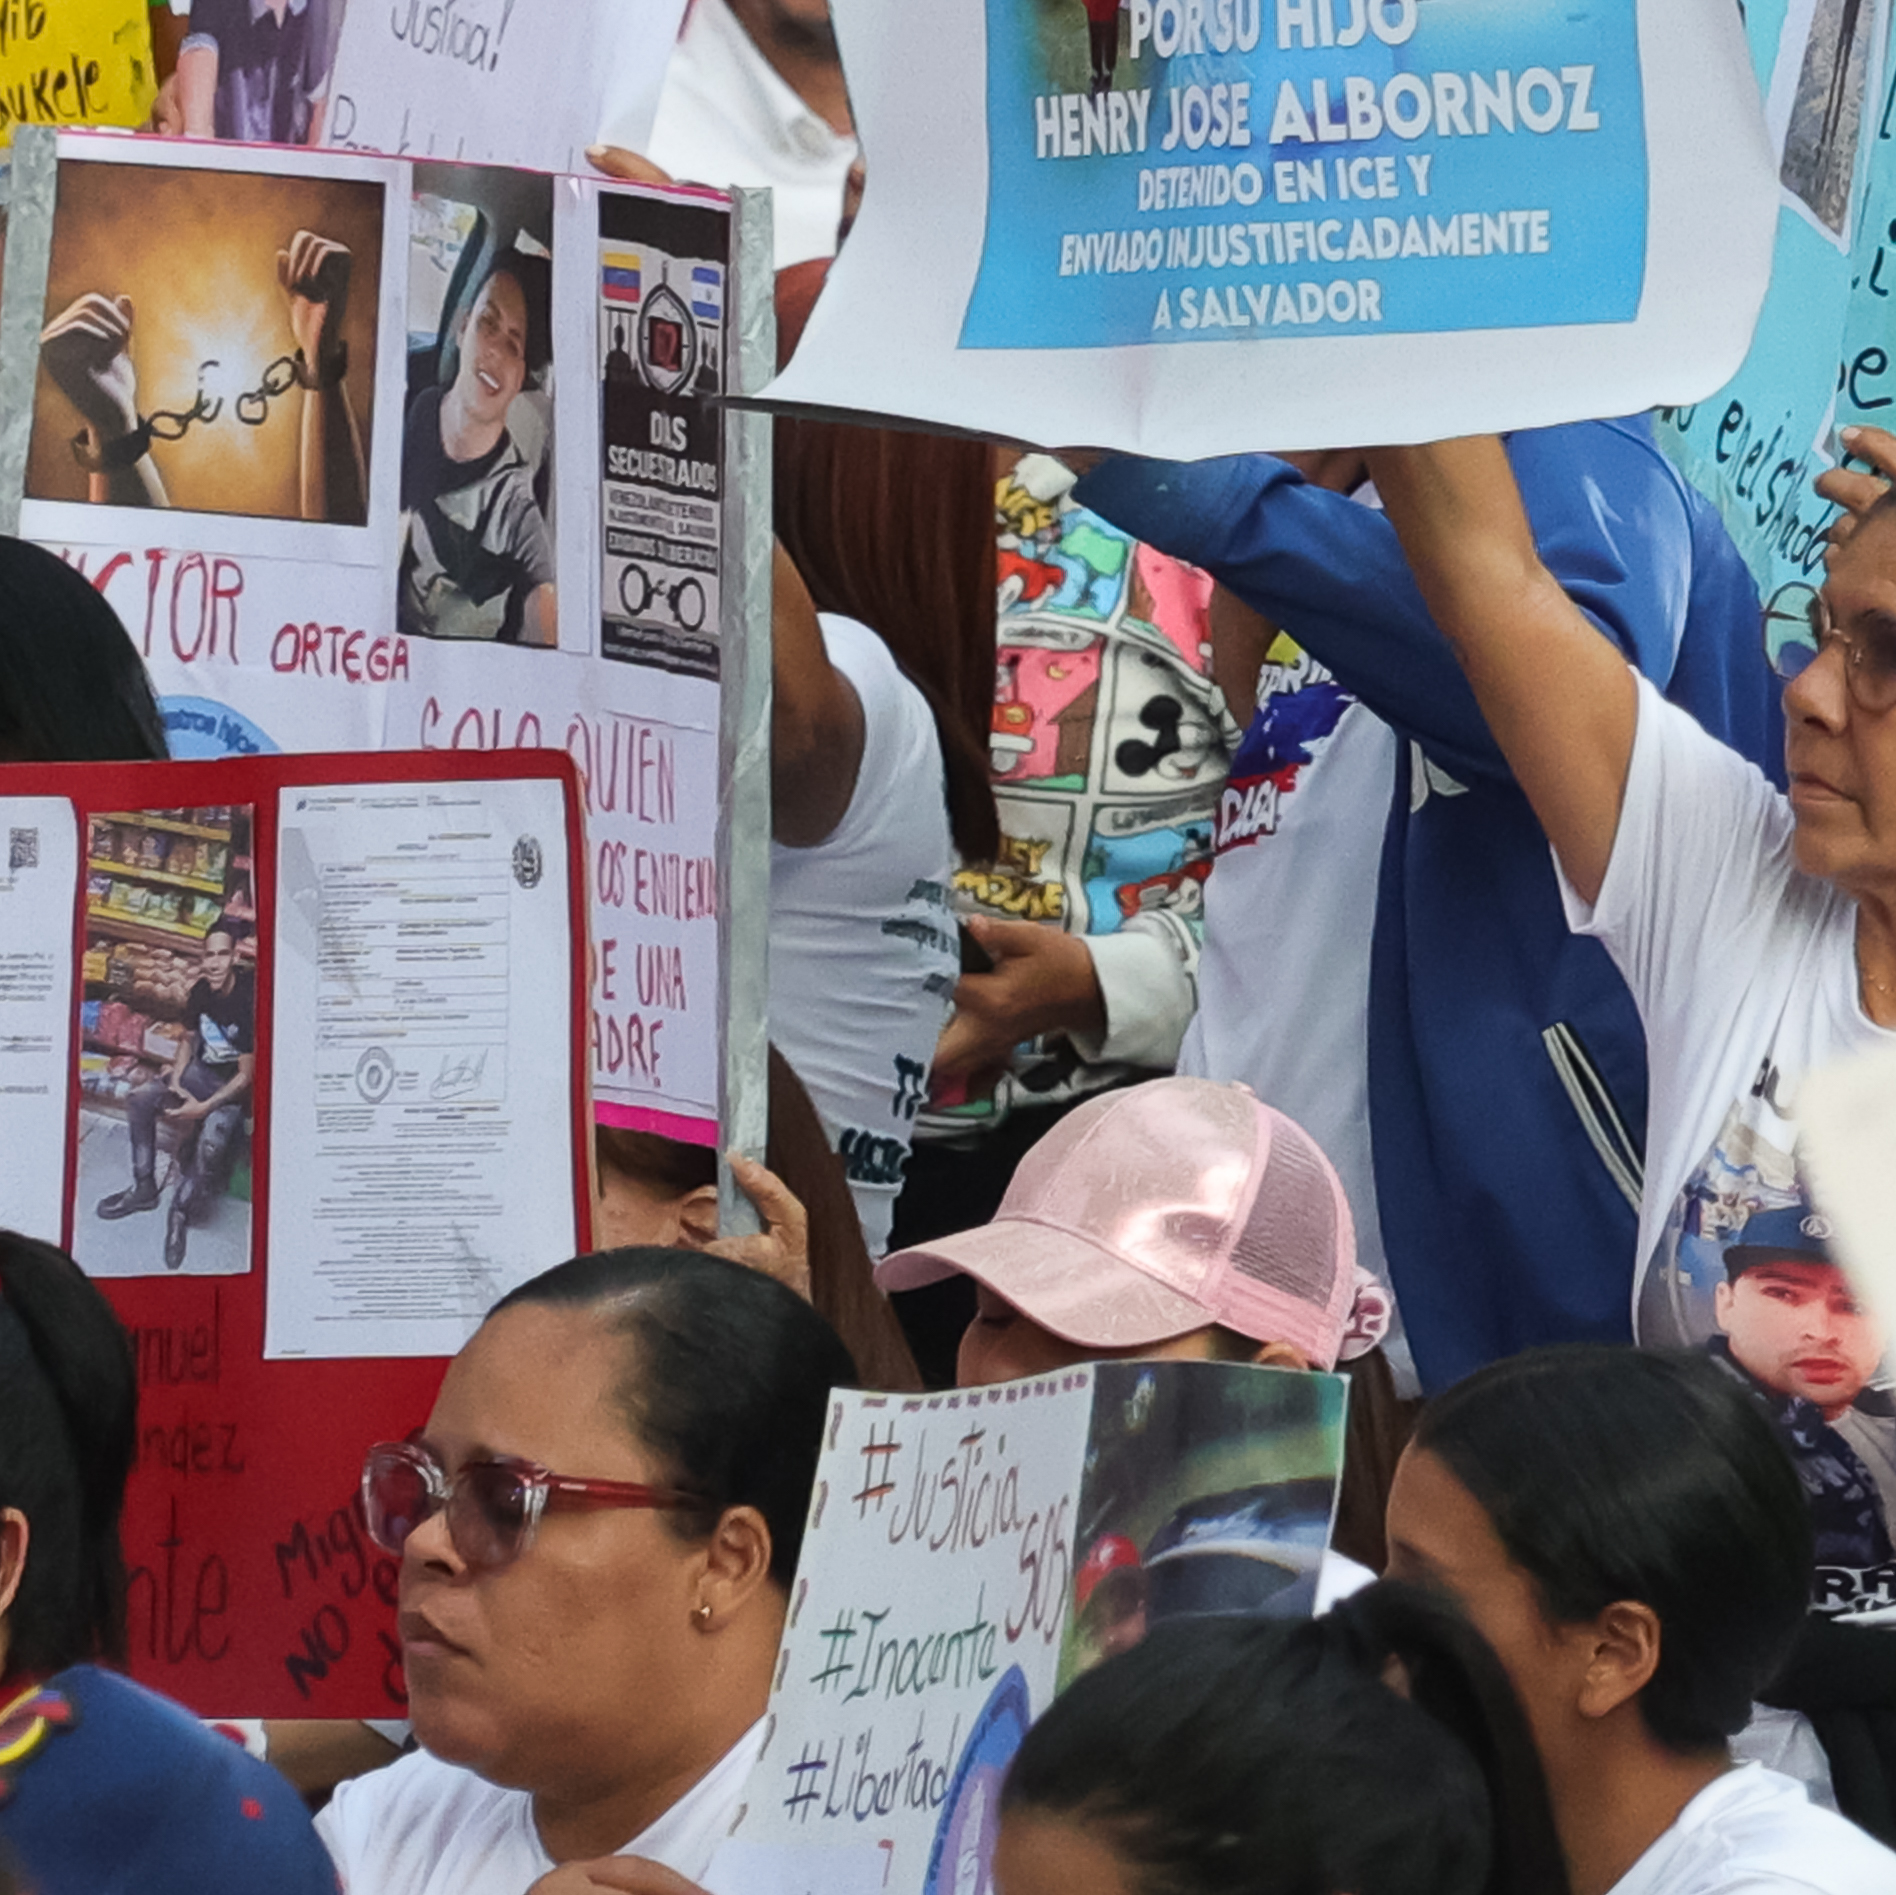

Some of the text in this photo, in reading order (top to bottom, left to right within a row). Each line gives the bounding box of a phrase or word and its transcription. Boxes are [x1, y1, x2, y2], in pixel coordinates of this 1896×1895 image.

[1035, 65, 1600, 159] HENRY JOSE ALBORNOZ
[1137, 155, 1432, 211] DETENIDO EN ICE Y
[1058, 209, 1551, 277] ENVIADO INJUSTIFICADAMENTE
[1152, 279, 1383, 332] A SALVADOR
[270, 622, 410, 682] ORTEGA
[636, 942, 687, 1012] UNA
[783, 1710, 962, 1824] #Libertad
